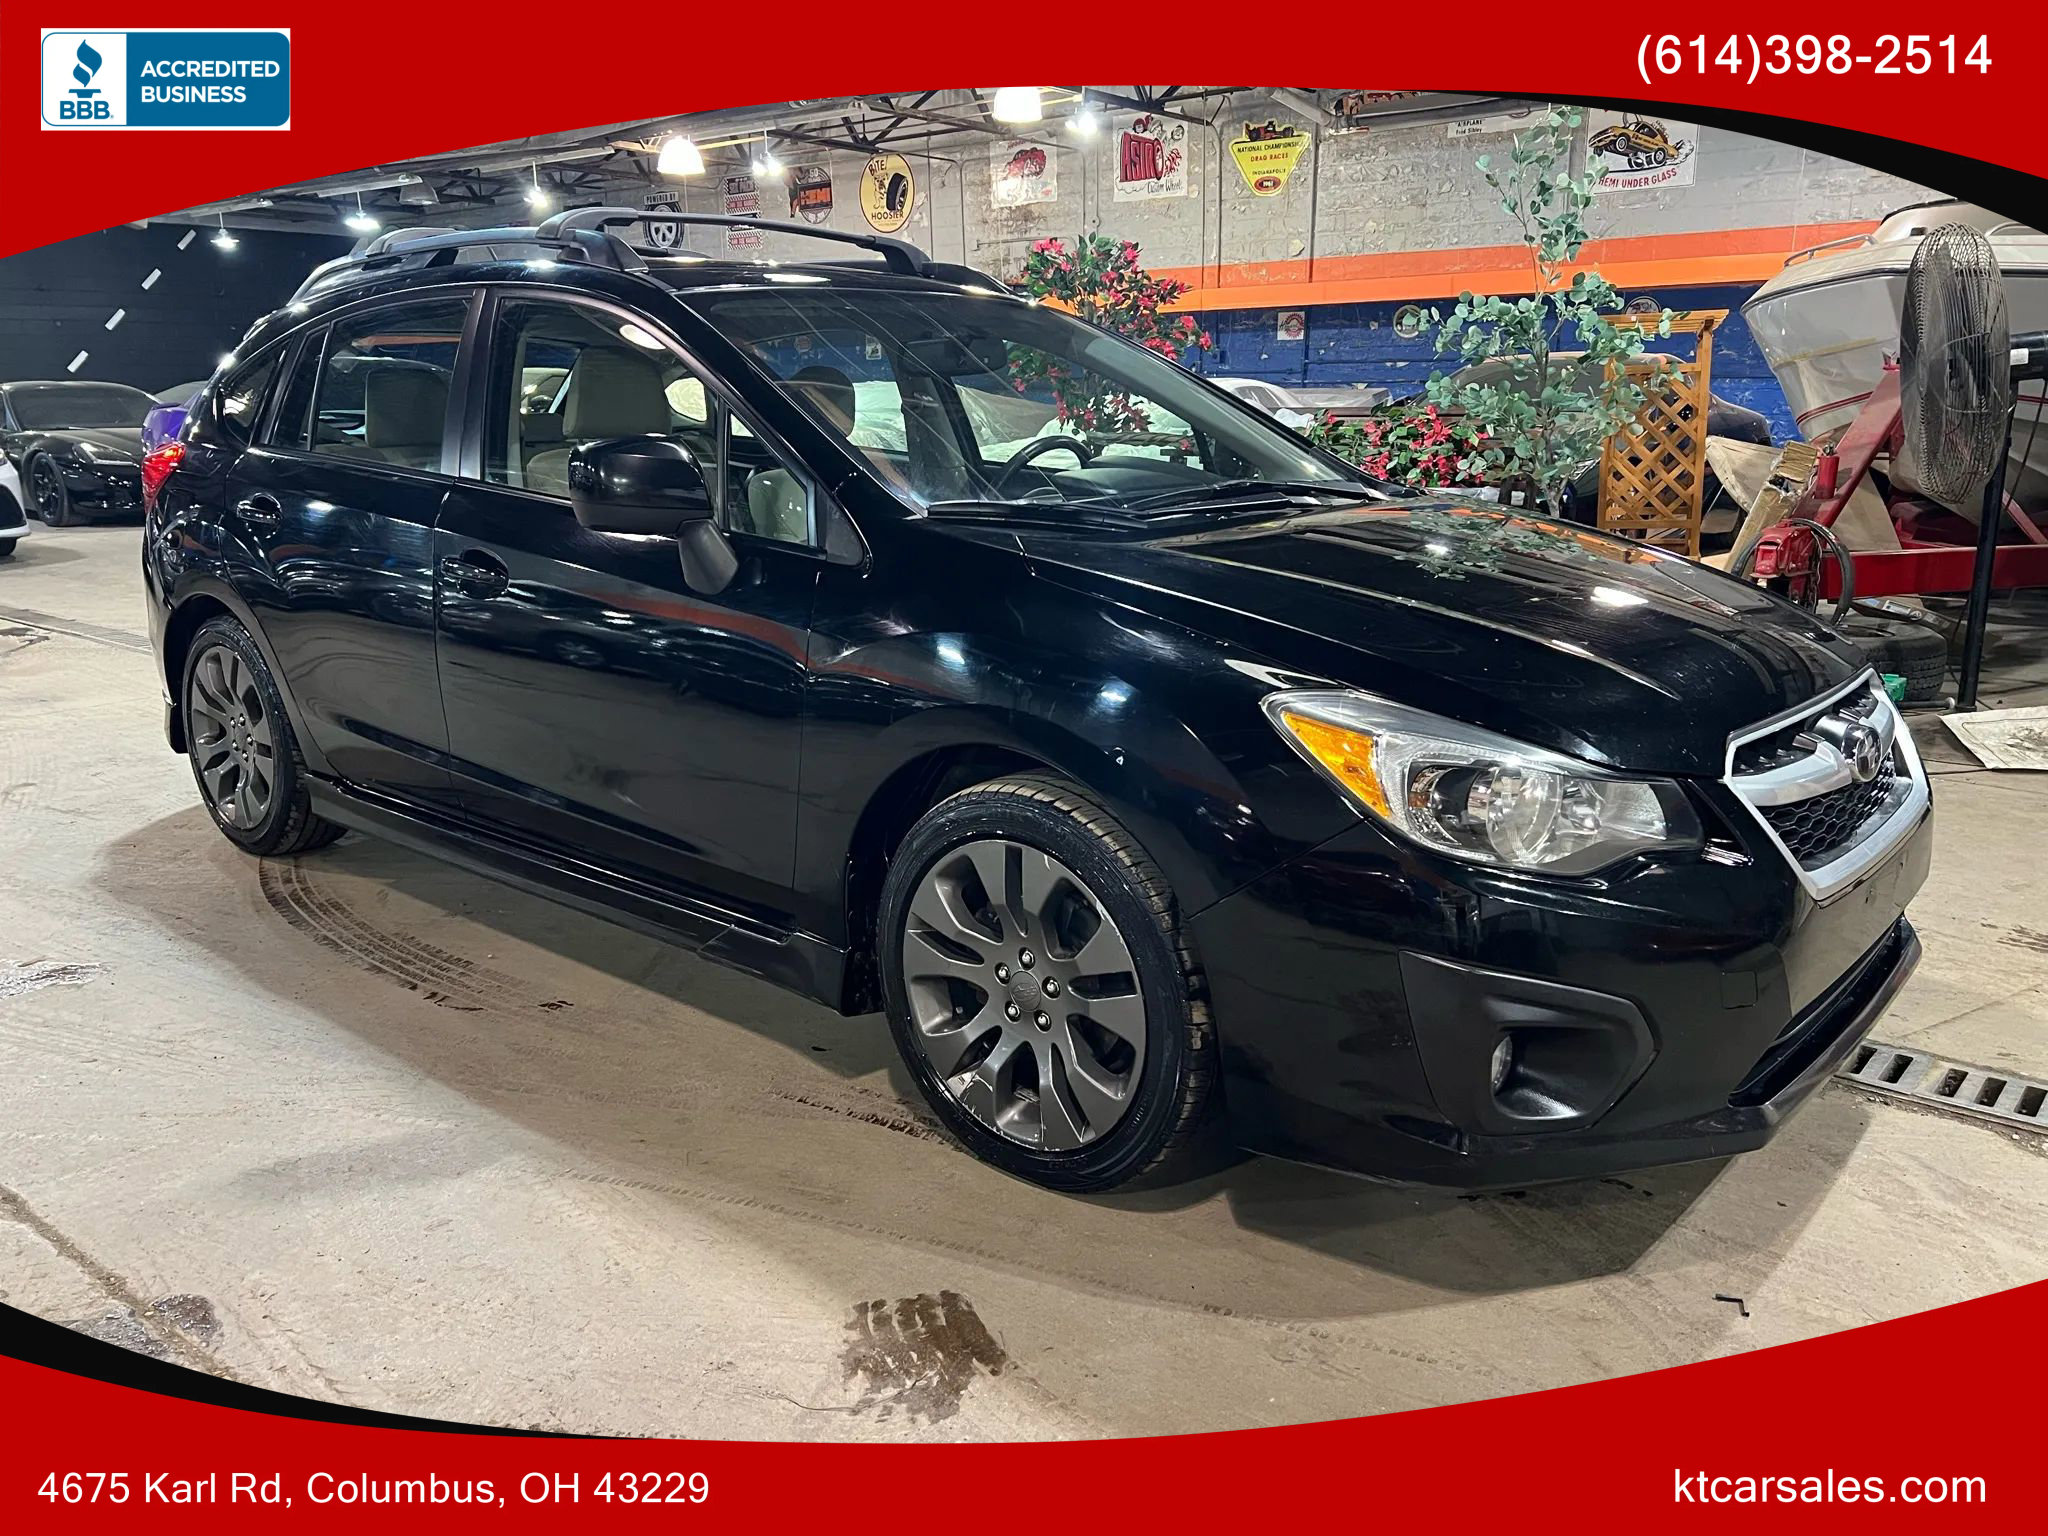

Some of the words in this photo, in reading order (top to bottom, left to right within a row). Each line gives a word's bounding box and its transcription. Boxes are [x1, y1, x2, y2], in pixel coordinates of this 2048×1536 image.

[1237, 143, 1262, 152] NATIONAL
[1119, 131, 1164, 182] ASTRO
[1250, 154, 1267, 162] DRAG
[1269, 152, 1289, 160] RACES
[1599, 177, 1618, 187] HEMI
[1621, 177, 1649, 188] UNDER
[1651, 168, 1677, 184] GLASS
[871, 211, 904, 220] HOOSIER
